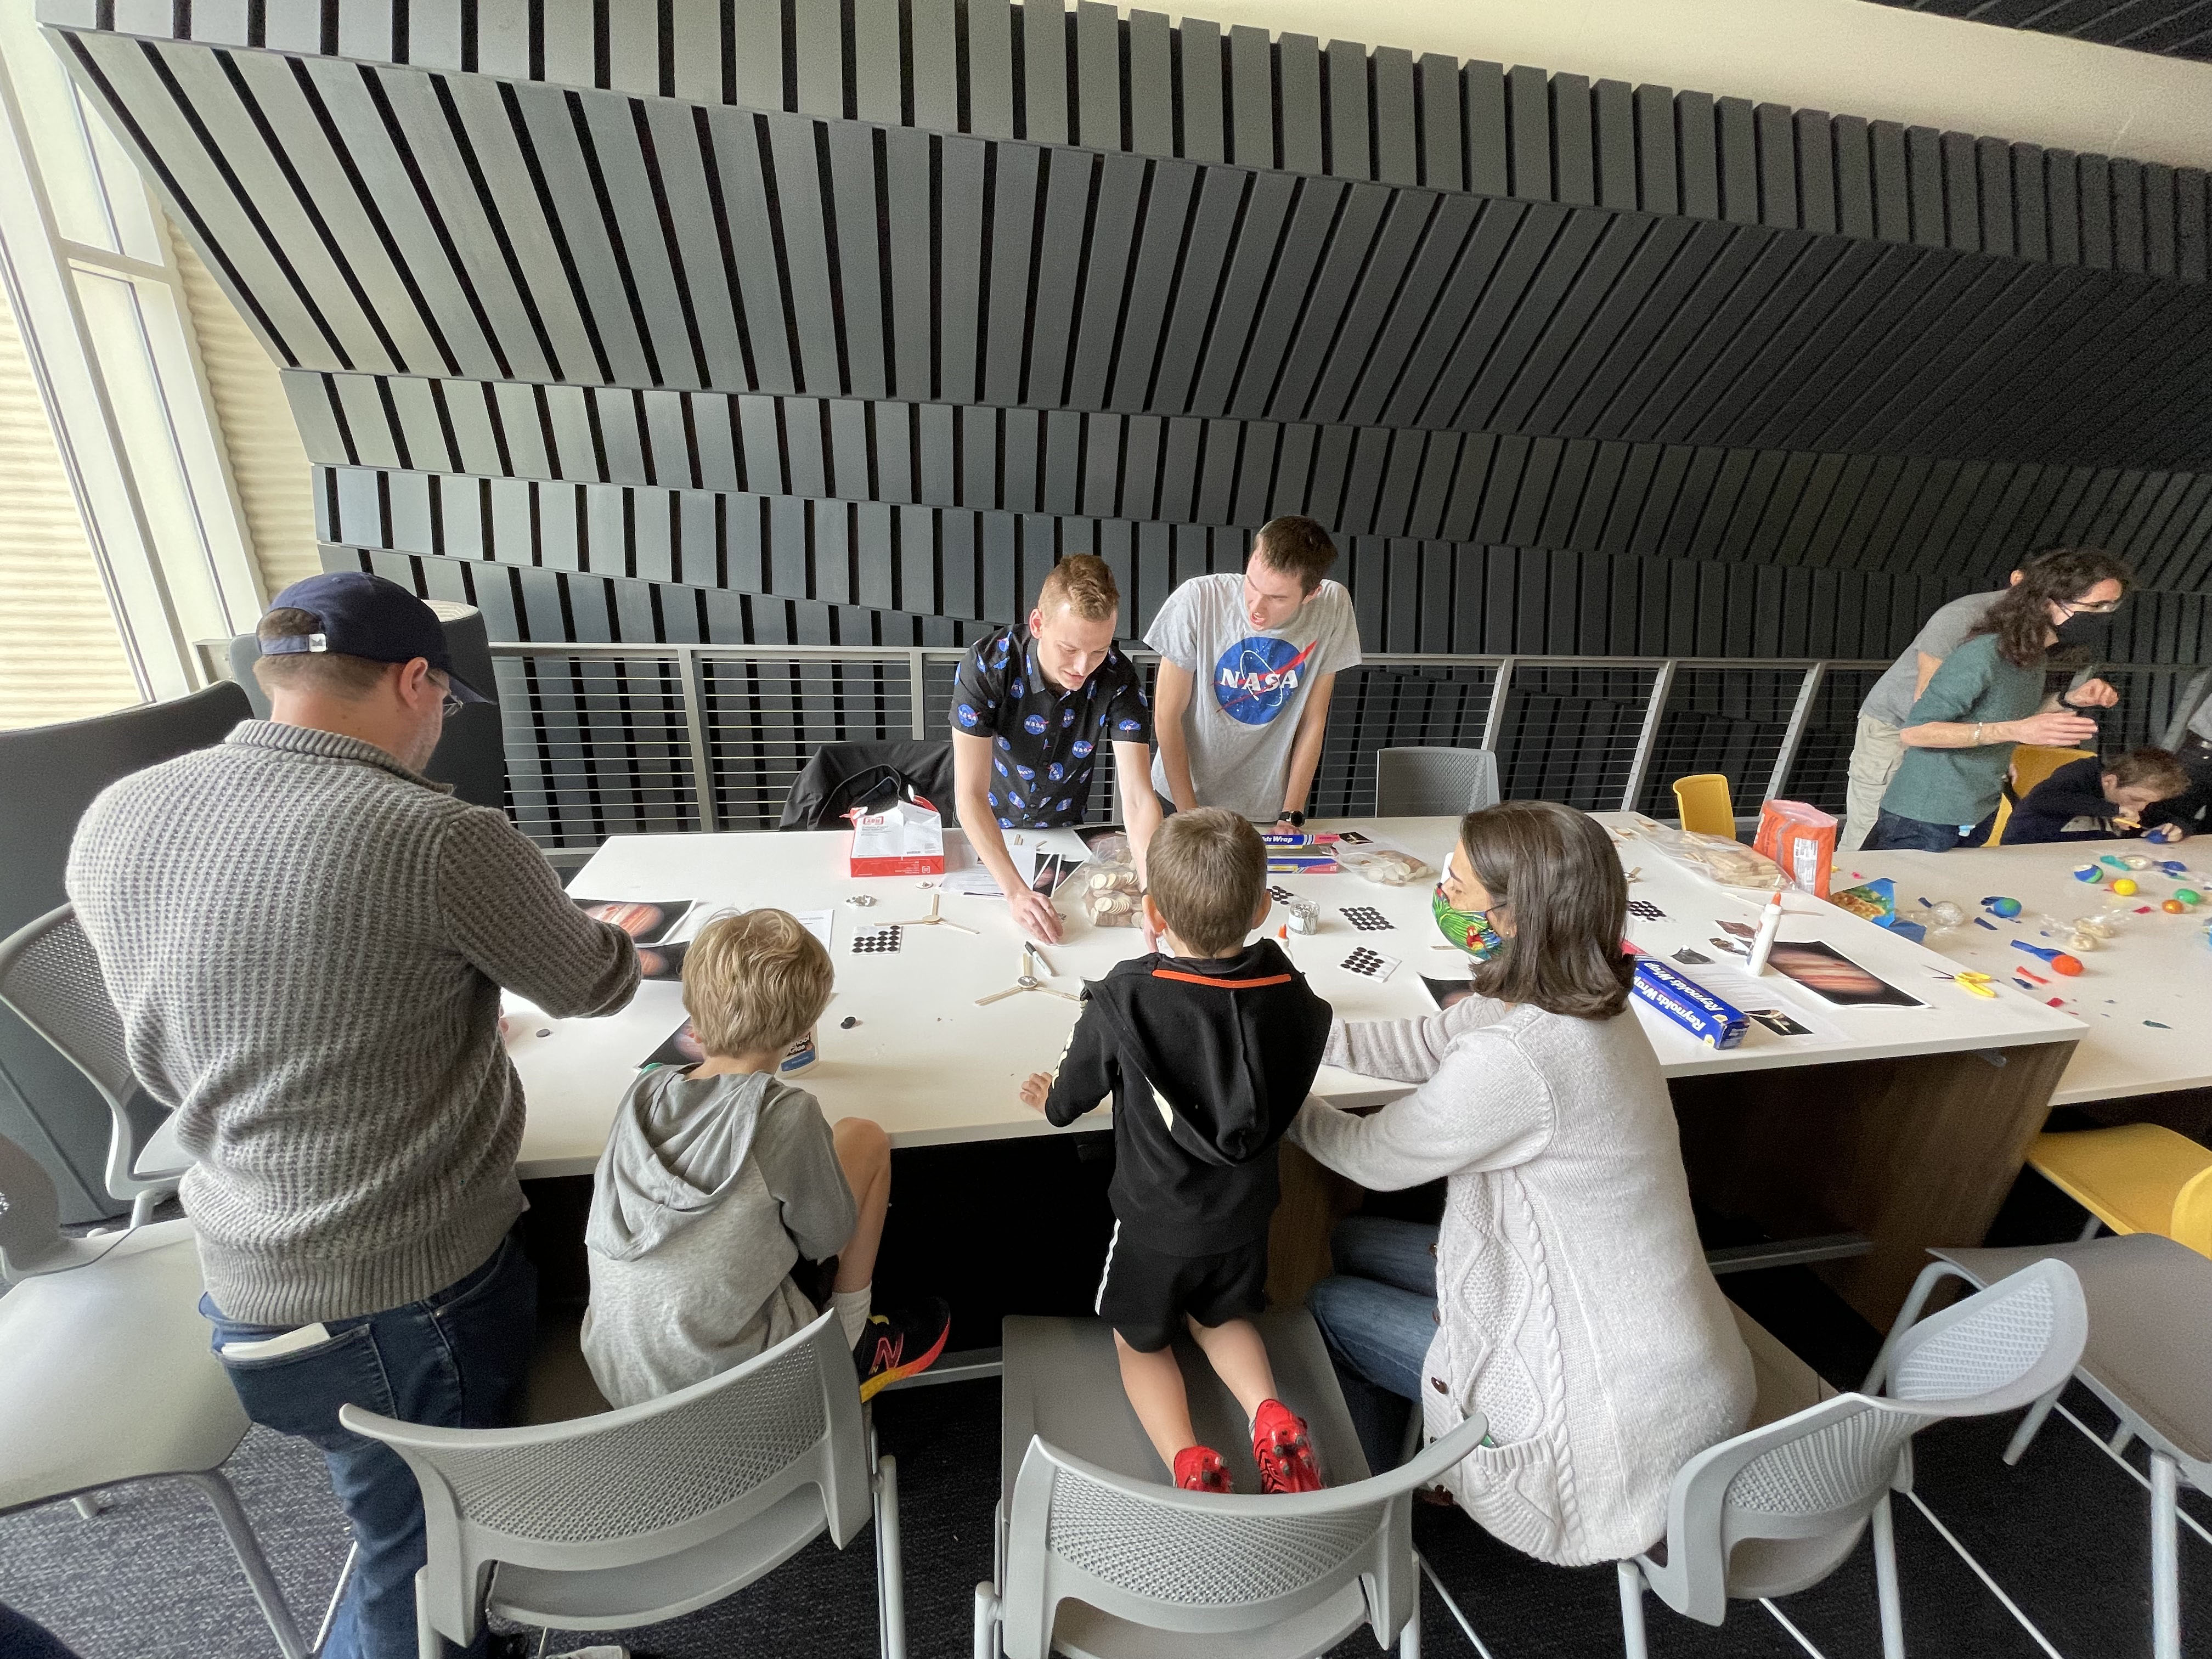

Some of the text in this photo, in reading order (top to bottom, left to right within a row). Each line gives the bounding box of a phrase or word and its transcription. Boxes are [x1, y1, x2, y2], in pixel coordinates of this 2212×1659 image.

[1220, 663, 1298, 692] NASA
[1025, 720, 1045, 730] NASA
[1644, 962, 1724, 1012] Reynolds Wrap
[1657, 992, 1707, 1032] Reynolds
[868, 1332, 904, 1375] N
